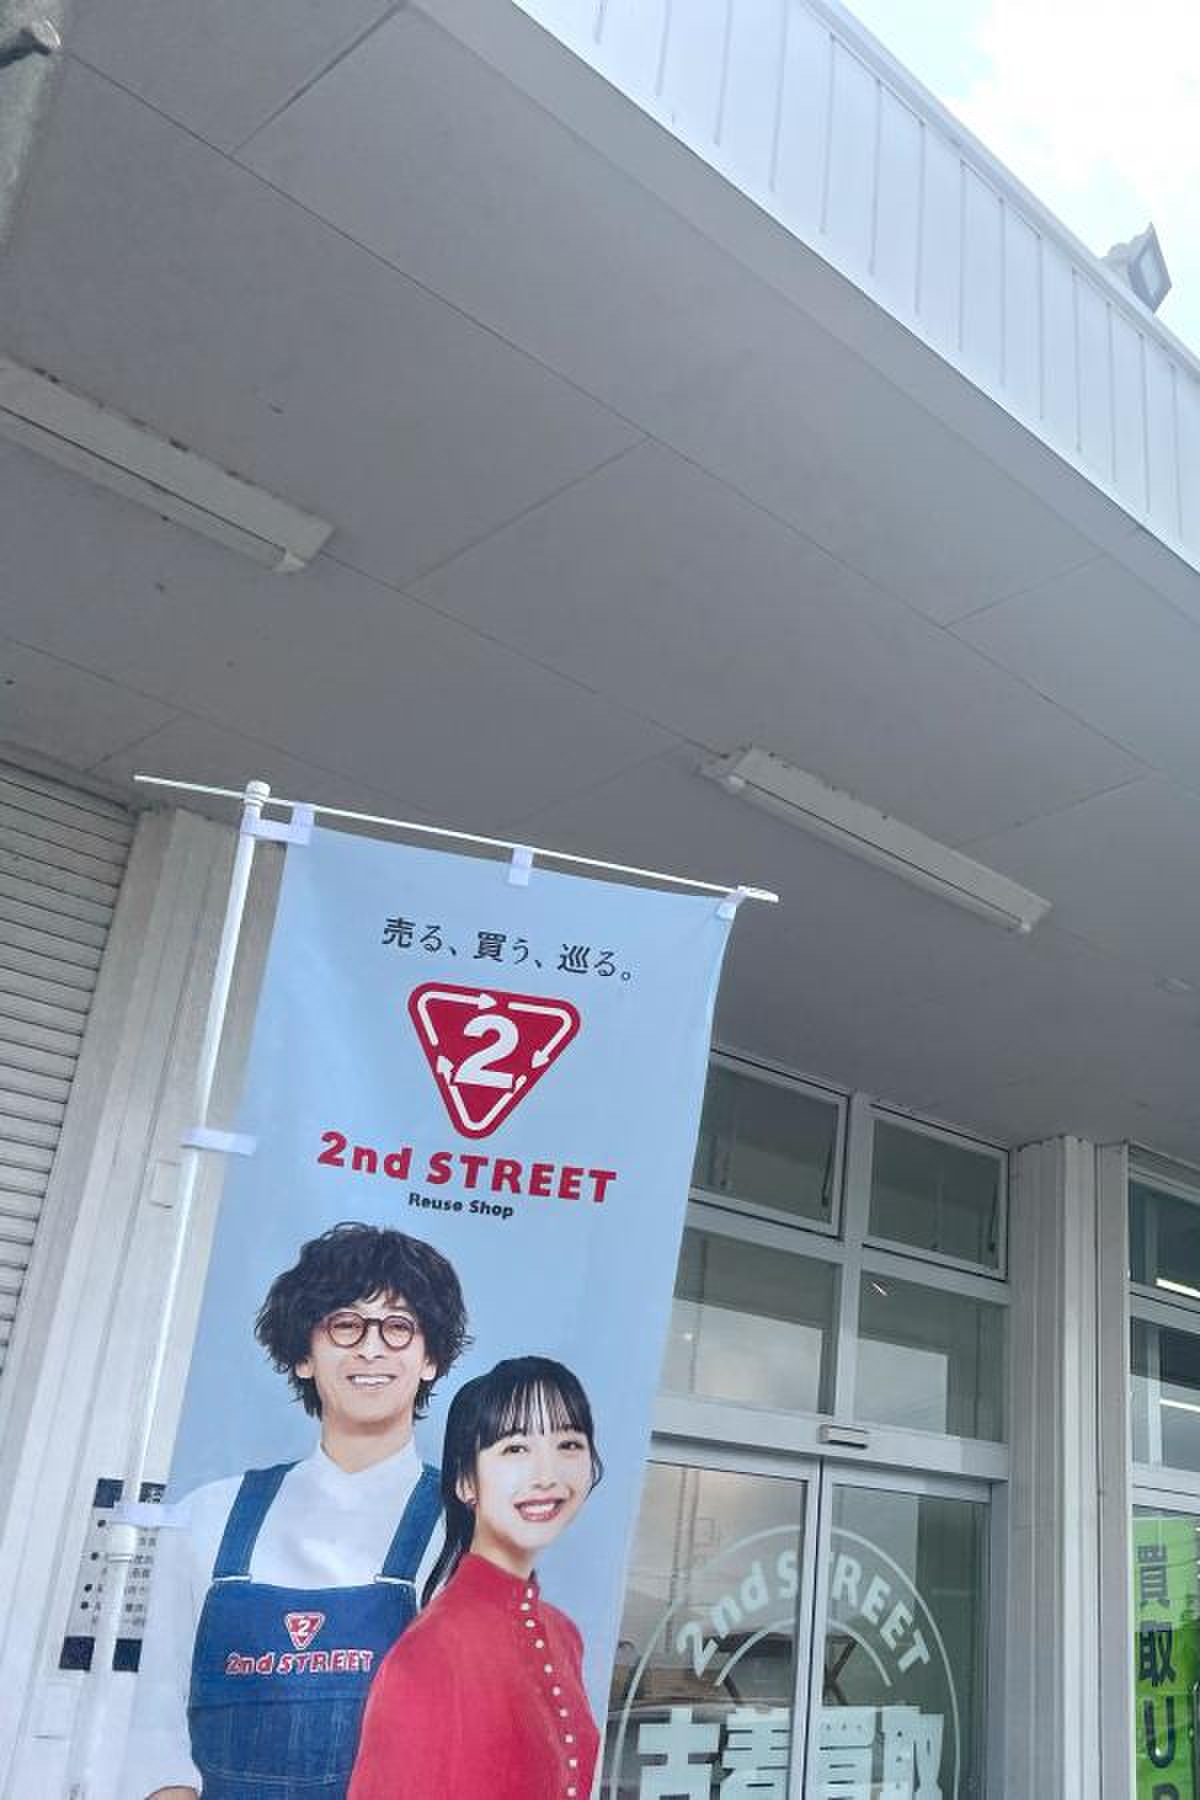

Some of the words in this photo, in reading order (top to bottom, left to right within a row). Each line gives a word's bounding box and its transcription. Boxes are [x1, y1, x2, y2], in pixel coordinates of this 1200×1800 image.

[382, 916, 632, 981] 売る、買う、巡る。
[451, 1013, 520, 1089] 2
[317, 1130, 413, 1180] 2nd
[426, 1150, 618, 1203] STREET
[408, 1193, 463, 1213] Reuse
[469, 1199, 515, 1219] Shop
[677, 1561, 769, 1679] 2nd
[776, 1551, 931, 1672] SREET
[225, 1651, 274, 1675] 2nd
[276, 1650, 374, 1675] STREET
[1137, 1546, 1179, 1800] 買取U
